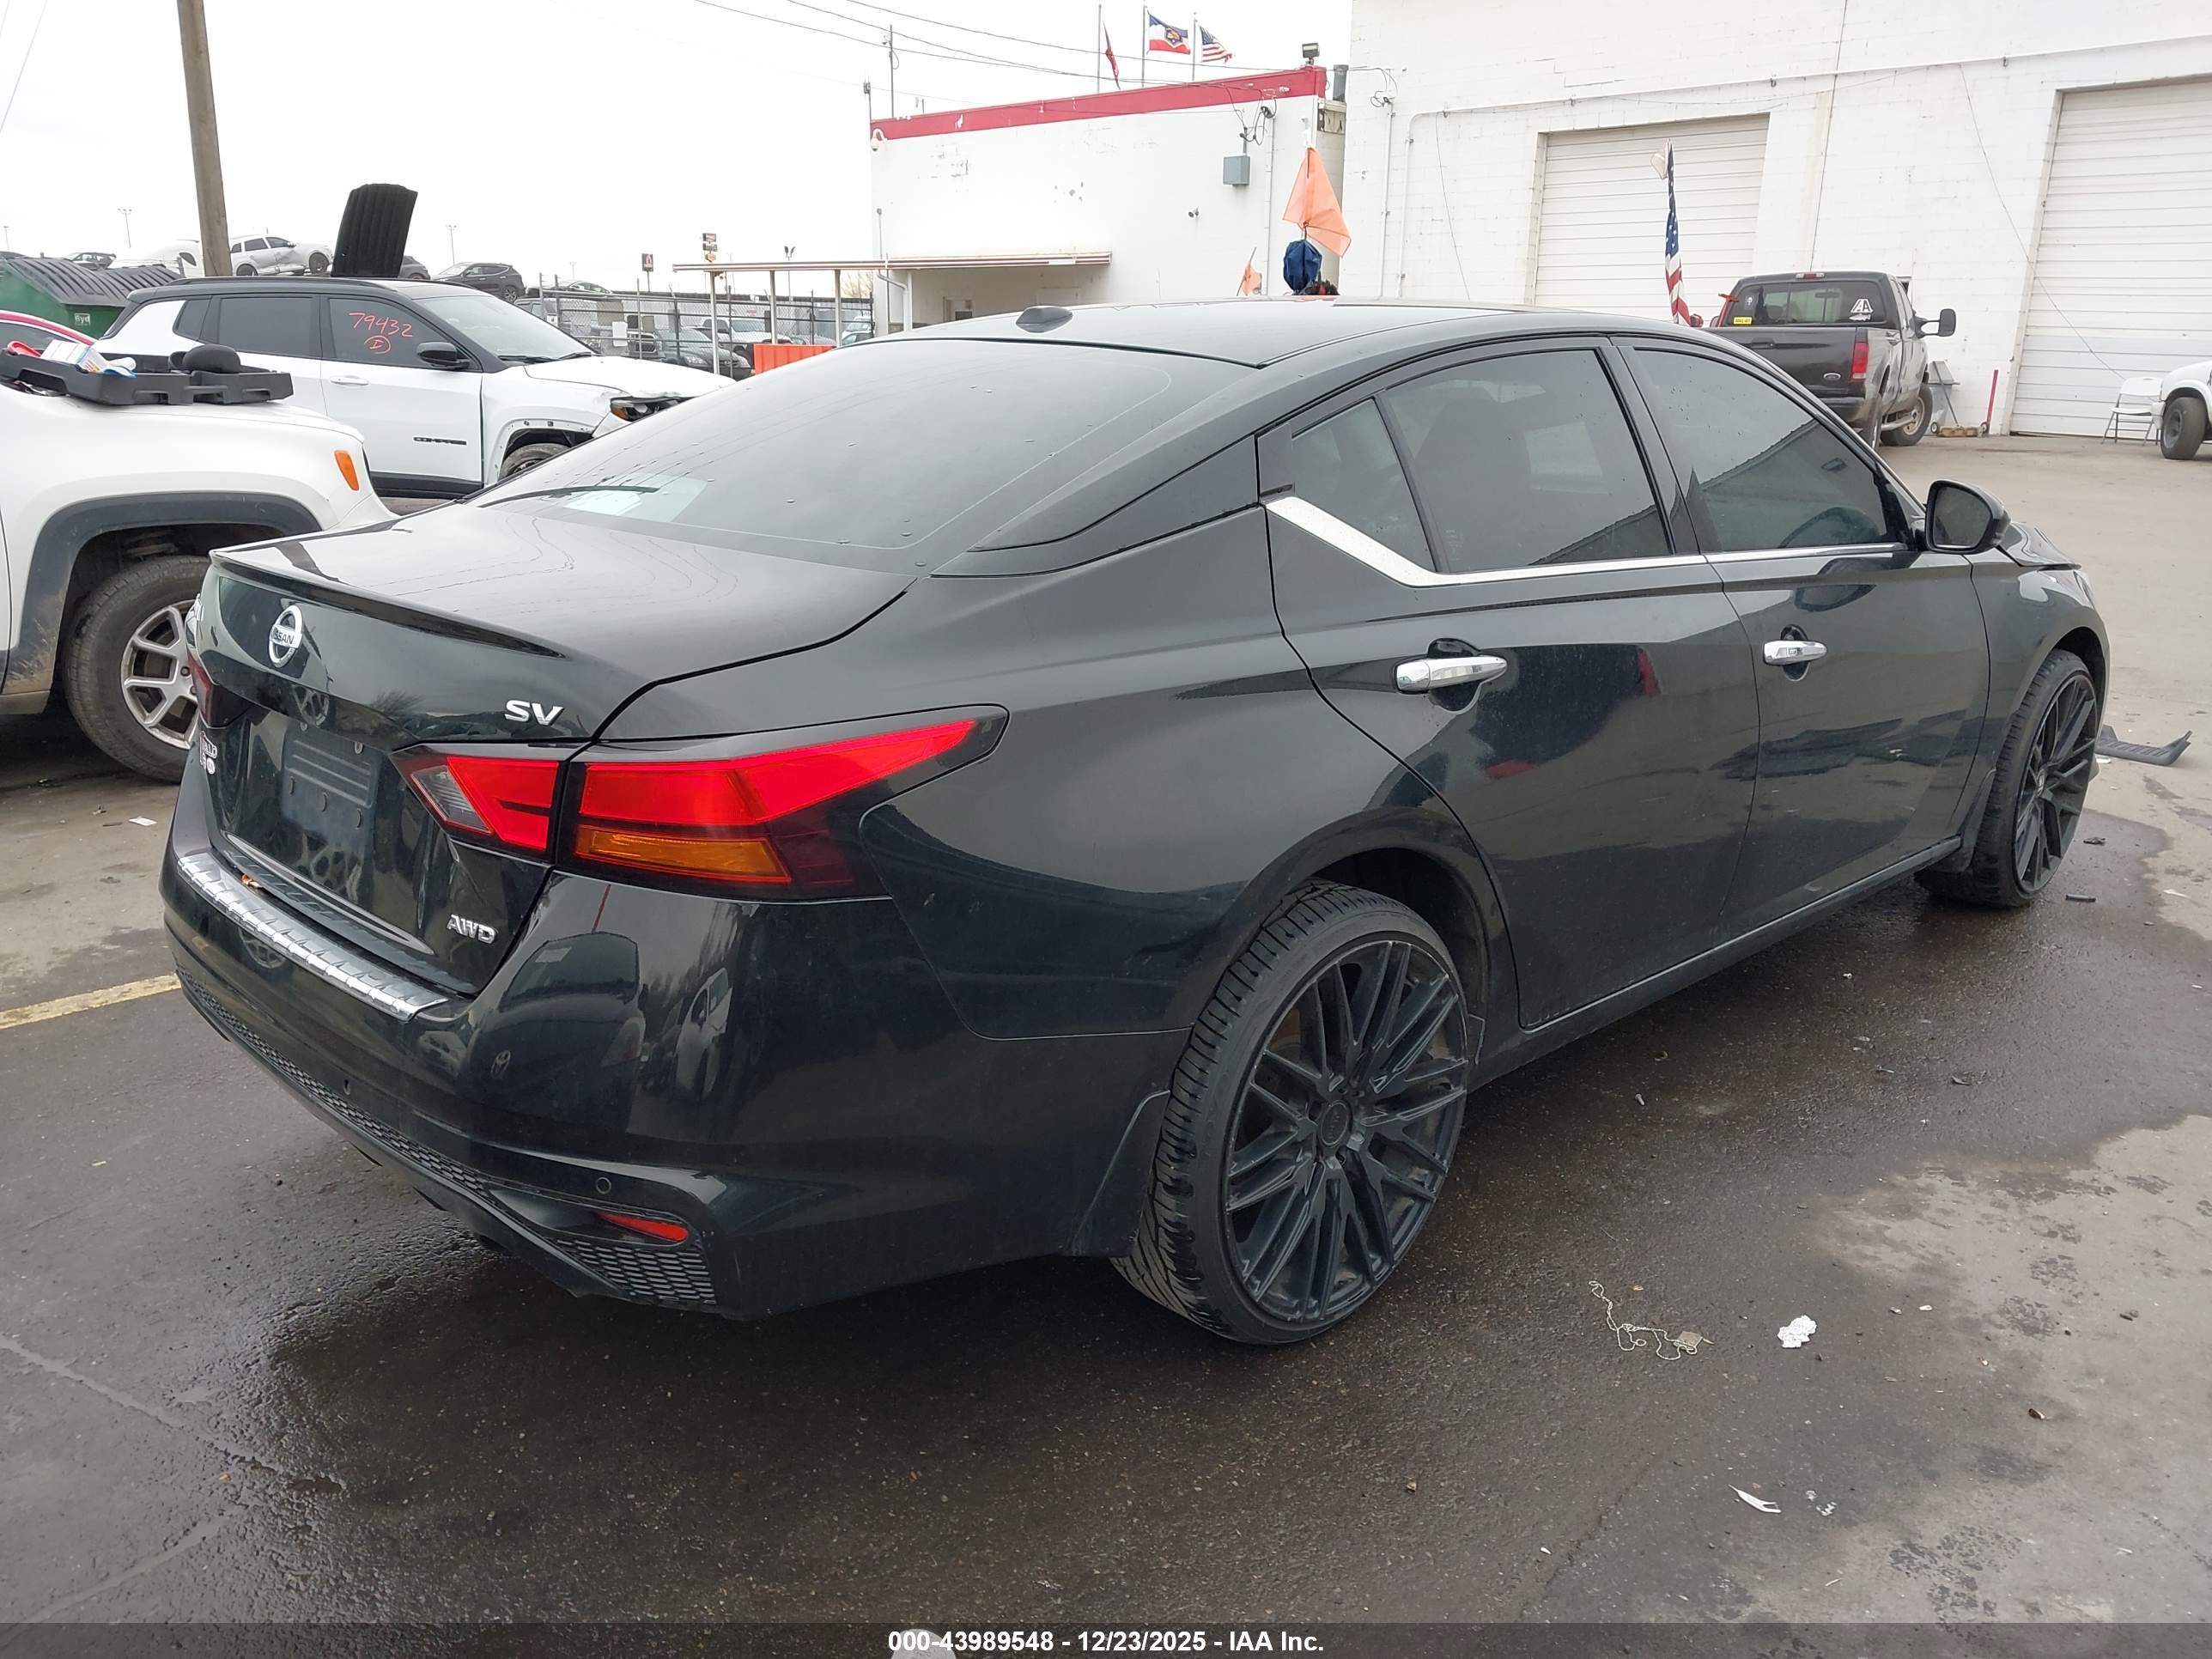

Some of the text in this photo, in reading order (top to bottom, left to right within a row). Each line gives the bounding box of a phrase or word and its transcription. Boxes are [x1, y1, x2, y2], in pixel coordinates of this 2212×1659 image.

[349, 313, 413, 337] 79432
[504, 699, 564, 726] SV
[447, 914, 495, 944] AWD
